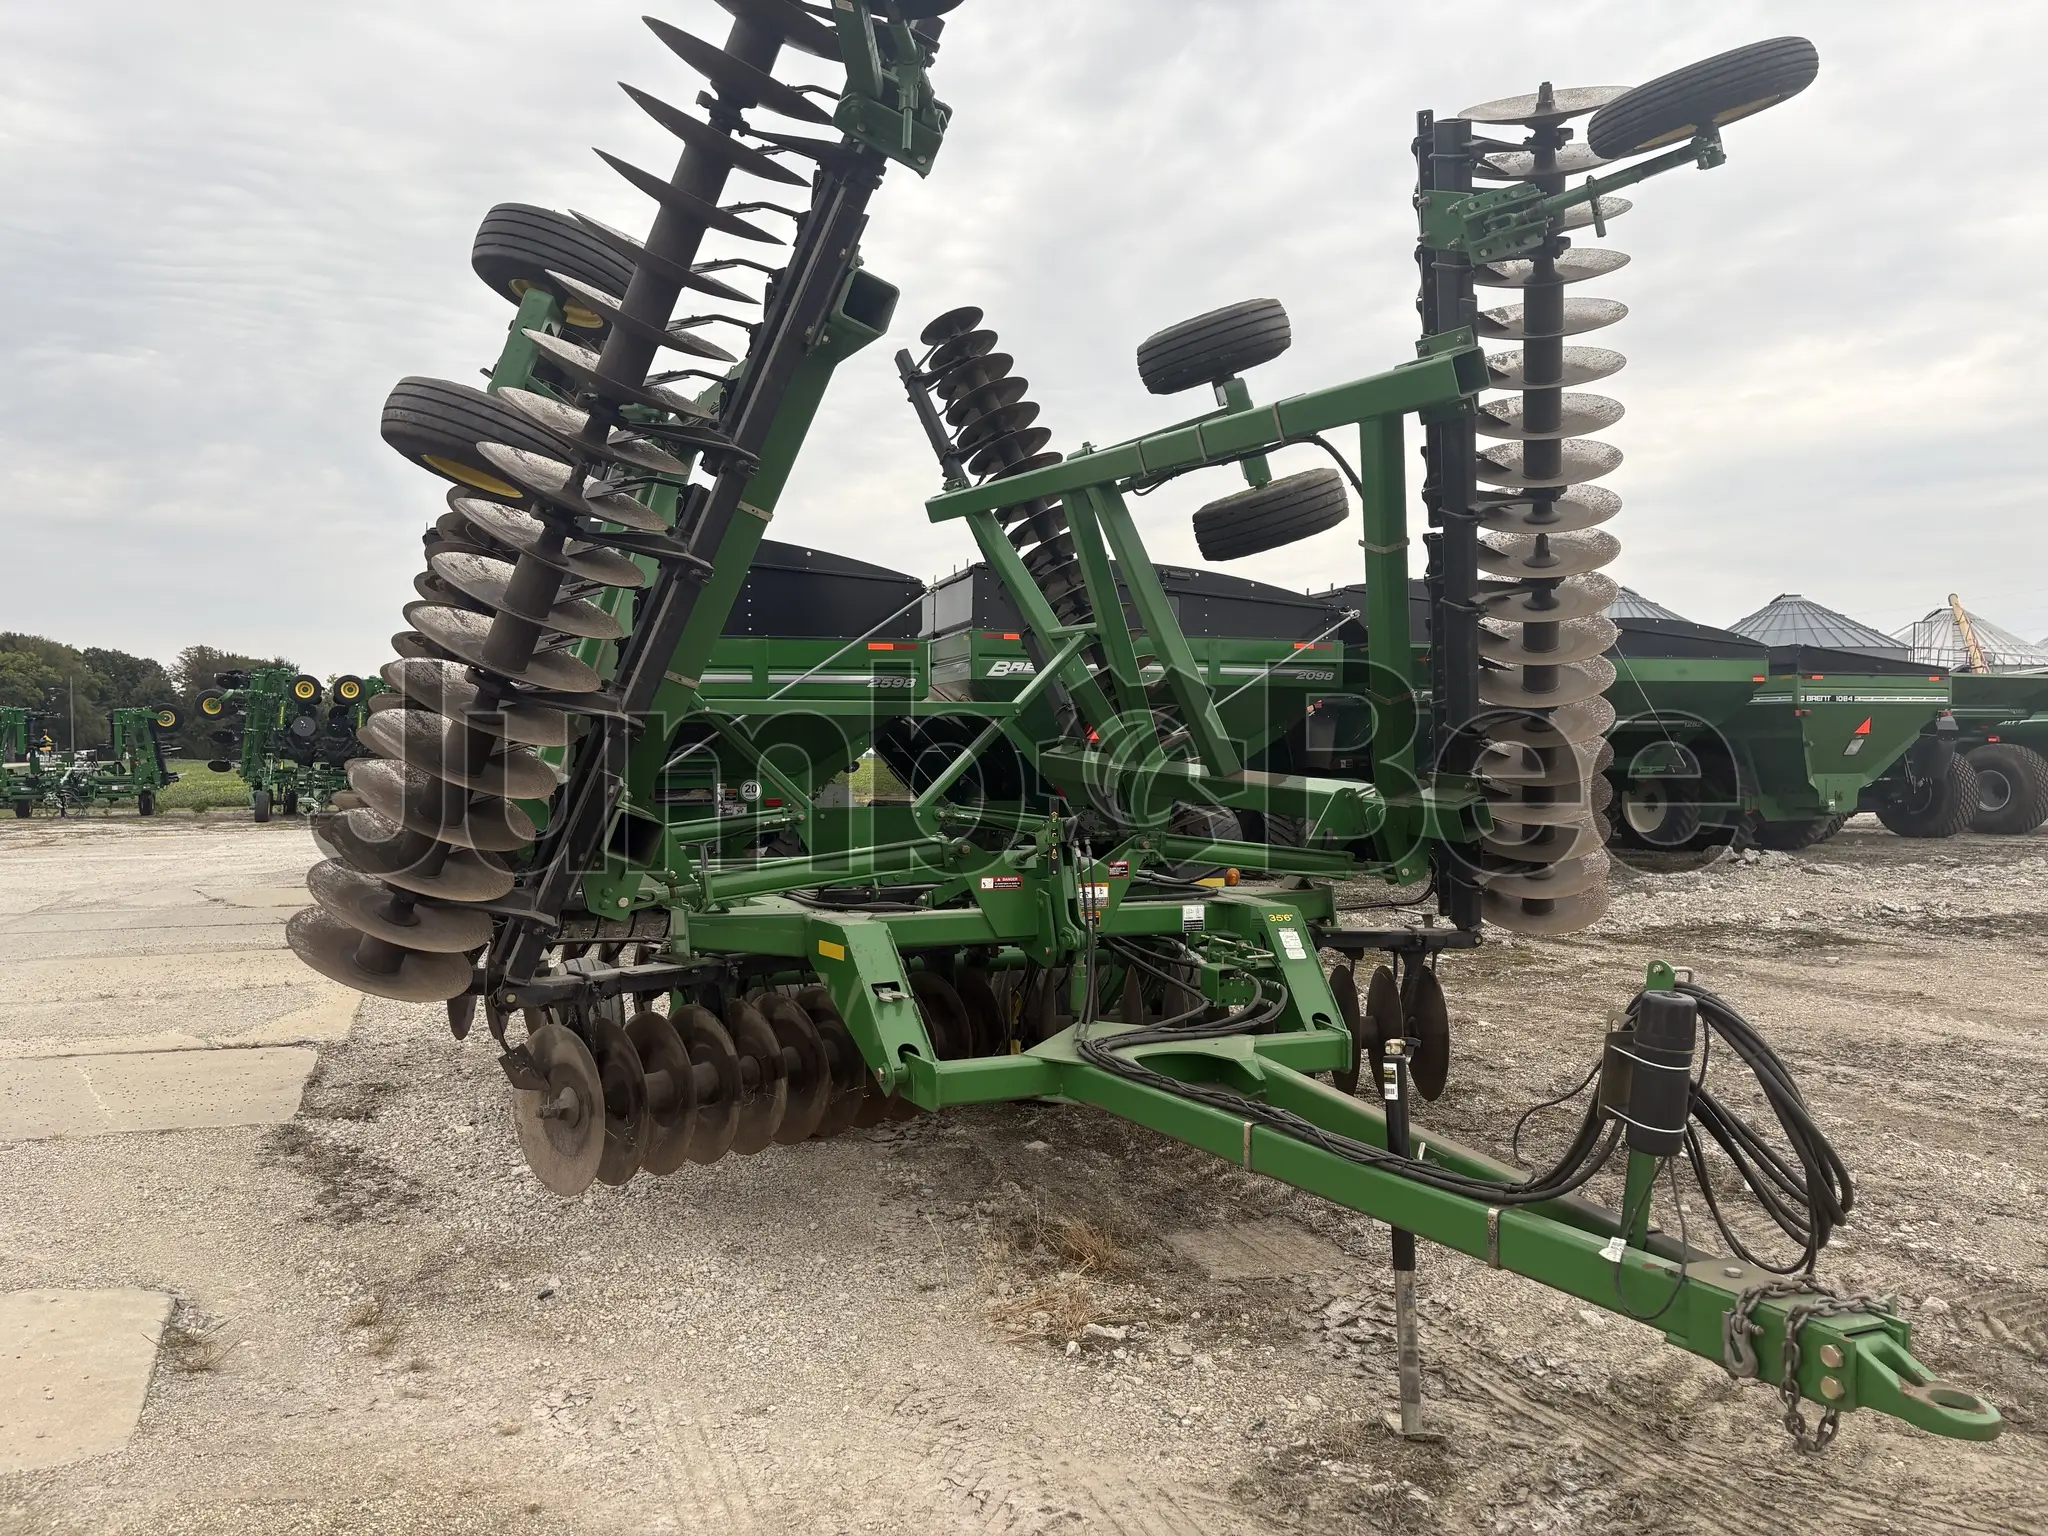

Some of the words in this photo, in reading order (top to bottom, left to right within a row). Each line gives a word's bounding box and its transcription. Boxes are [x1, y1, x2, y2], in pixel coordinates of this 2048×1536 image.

[986, 661, 1037, 677] BRE
[1295, 670, 1335, 681] 2098
[867, 677, 917, 688] 2598
[744, 784, 757, 794] 20
